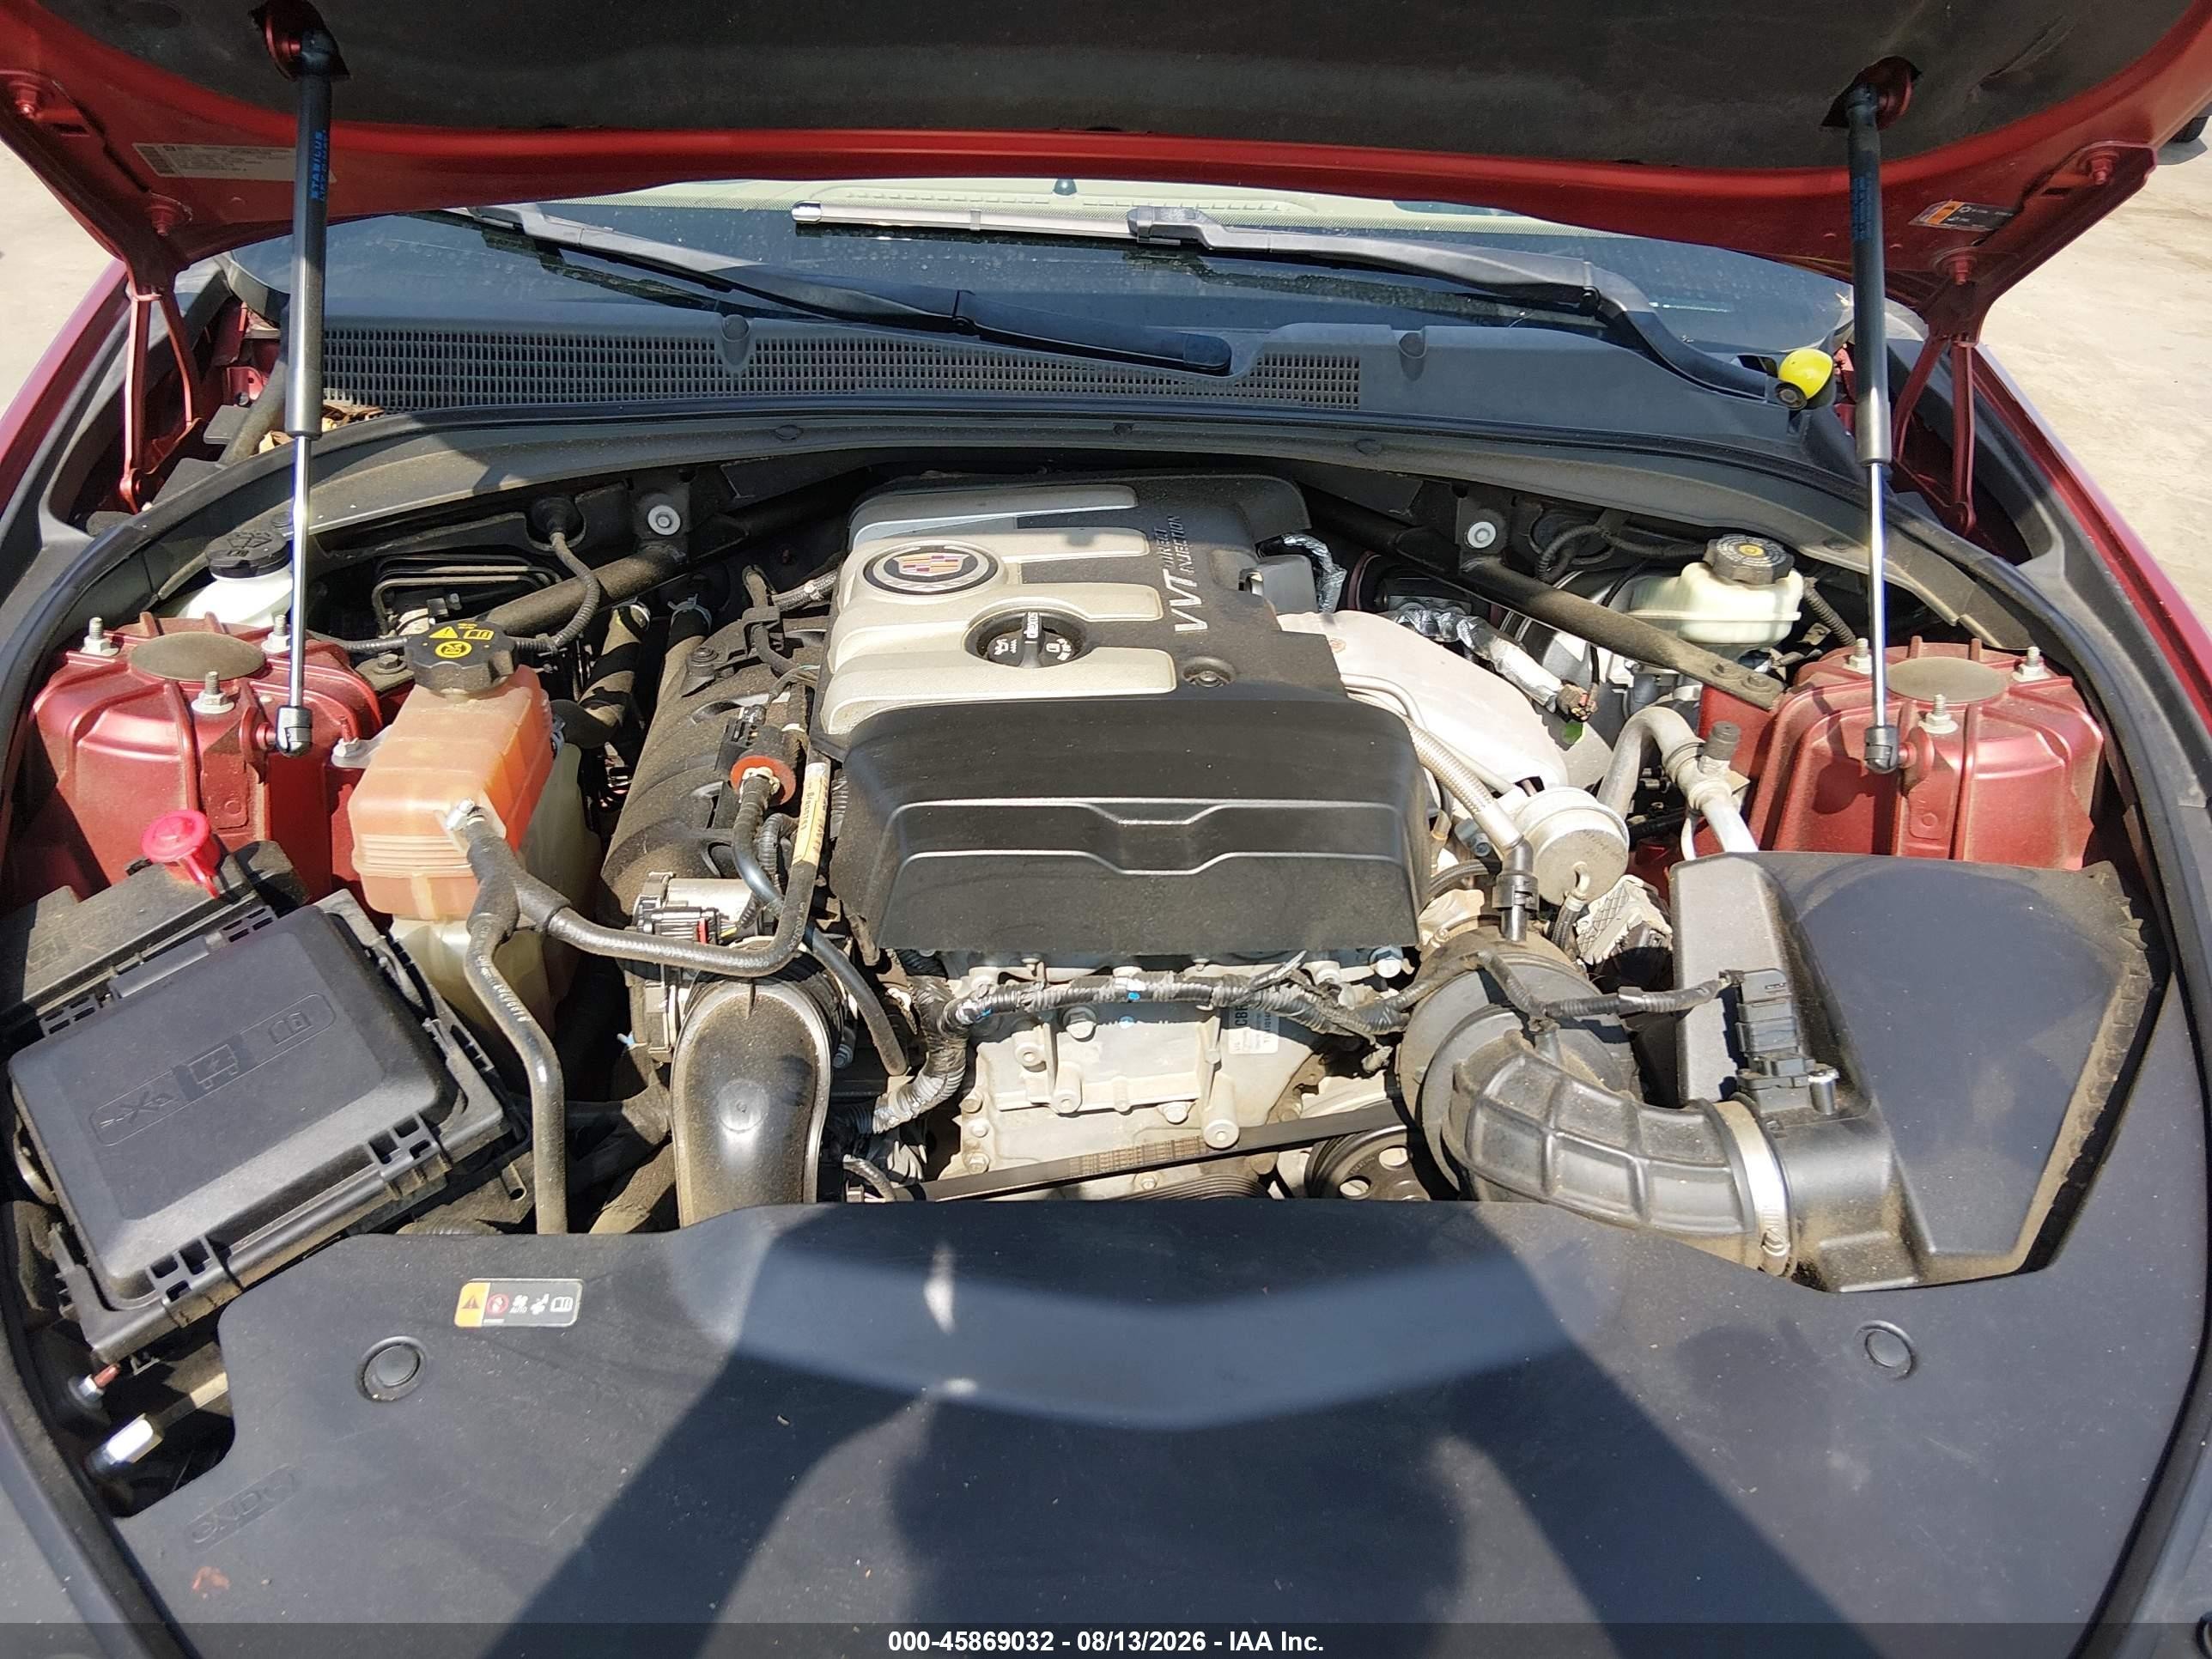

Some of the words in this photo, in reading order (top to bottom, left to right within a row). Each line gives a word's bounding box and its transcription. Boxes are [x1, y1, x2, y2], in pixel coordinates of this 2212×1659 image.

[1153, 526, 1174, 568] DIRECT
[1168, 515, 1195, 574] INJECTION
[1162, 568, 1208, 633] VVT
